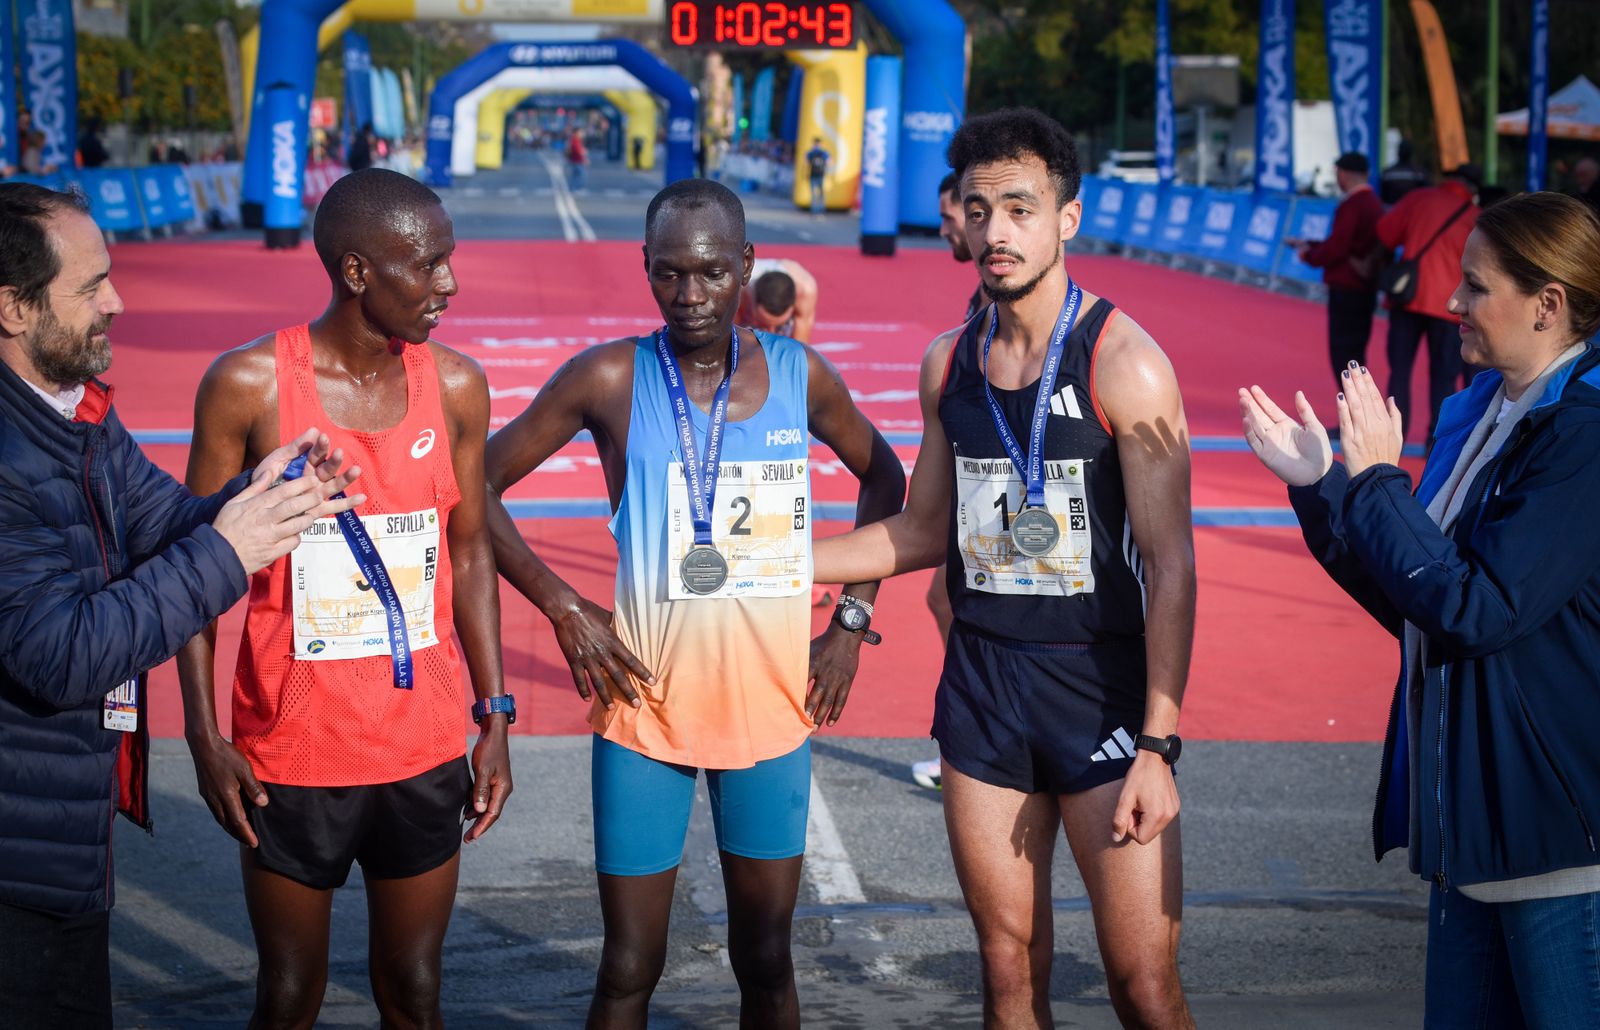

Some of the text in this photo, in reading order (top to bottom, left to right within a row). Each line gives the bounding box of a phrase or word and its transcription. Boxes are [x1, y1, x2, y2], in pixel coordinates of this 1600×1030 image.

[1259, 42, 1289, 190] HOKA
[272, 120, 297, 198] HOKA
[863, 107, 888, 189] HOKA
[1055, 323, 1068, 345] MEDIO
[1063, 291, 1078, 322] MARATÓN
[667, 366, 679, 388] MEDIO
[714, 400, 724, 424] MEDIO
[992, 403, 1008, 437] MARATÓN
[1005, 436, 1014, 448] DE
[1032, 355, 1057, 481] MEDIO MARATÓN DE SEVILLA 2024
[708, 425, 720, 461] MARATÓN
[766, 428, 803, 447] HOKA
[676, 397, 705, 521] MEDIO MARATÓN DE SEVILLA 2024
[706, 462, 715, 473] DE
[717, 463, 795, 482] RATÓN SEVILLA
[963, 460, 1013, 475] MEDIO MARATÓN
[387, 513, 425, 534] SEVILLA
[729, 496, 752, 536] 2
[993, 492, 1010, 531] 1
[303, 523, 327, 536] MEDIO
[343, 509, 362, 538] EVILLA
[358, 536, 372, 555] 2024
[373, 563, 389, 588] MEDIO
[735, 581, 754, 590] HOKA
[1015, 577, 1034, 586] HOKA
[384, 588, 401, 630] MARATÓN
[363, 637, 385, 647] HOKA
[394, 629, 403, 641] DE
[396, 642, 406, 677] SEVILLA
